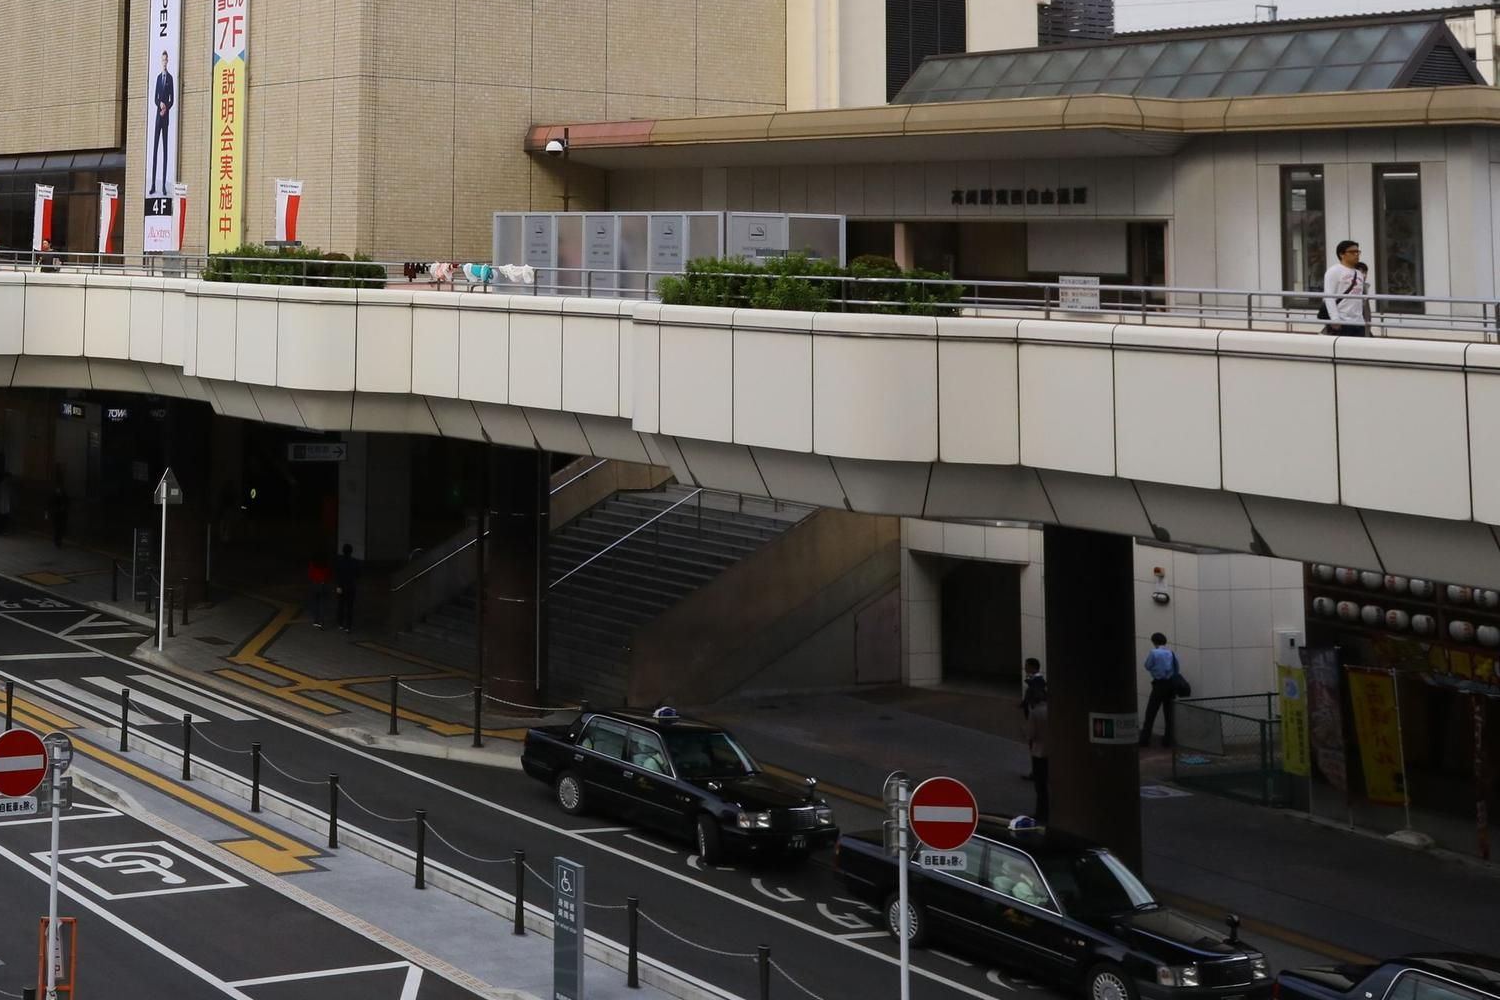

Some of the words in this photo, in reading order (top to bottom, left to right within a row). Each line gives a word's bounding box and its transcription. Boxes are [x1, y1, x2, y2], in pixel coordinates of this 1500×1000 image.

[217, 16, 244, 51] 7F
[218, 68, 236, 240] 説明会実施中
[152, 199, 167, 215] 4F
[0, 801, 35, 813] 自転車を除く
